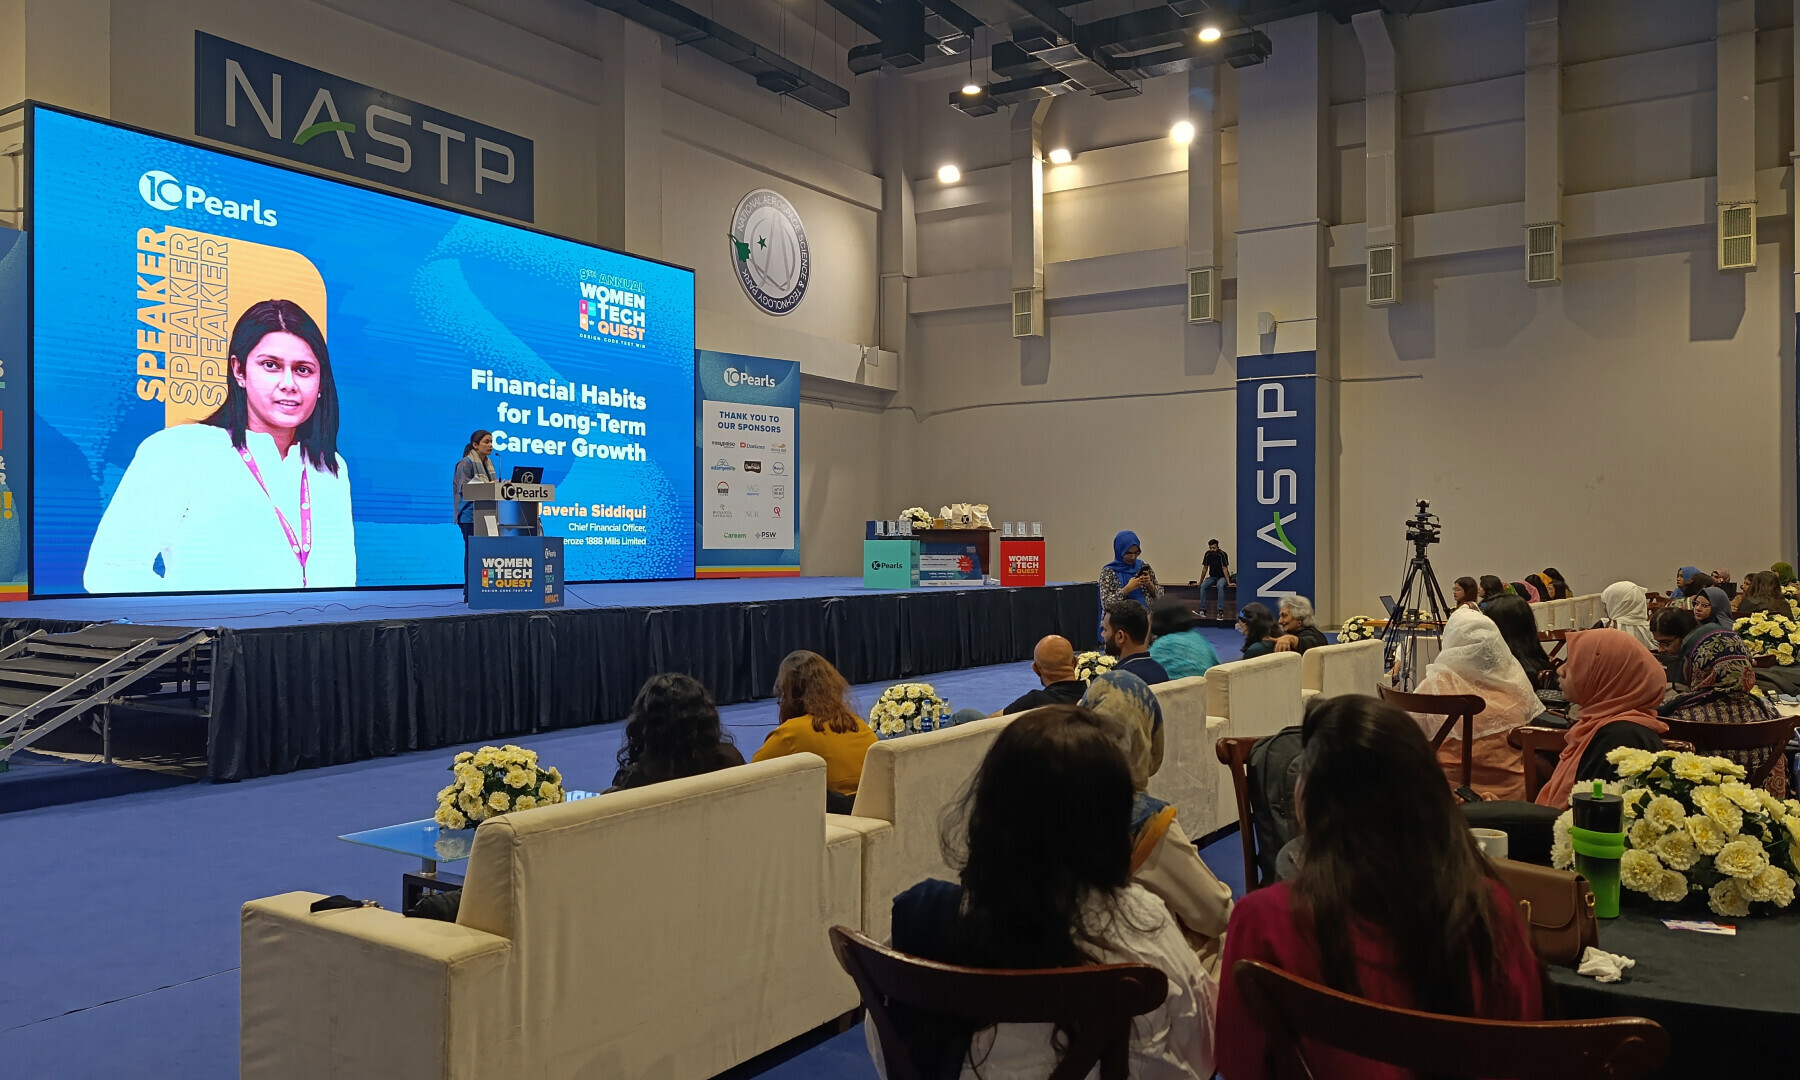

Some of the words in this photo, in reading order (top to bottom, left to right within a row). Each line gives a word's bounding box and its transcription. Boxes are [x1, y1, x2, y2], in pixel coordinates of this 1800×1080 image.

[225, 58, 515, 195] NASTP
[138, 170, 278, 227] 10Pearls
[737, 196, 763, 232] NATIONAL
[763, 195, 802, 232] AEROSPACE
[798, 235, 808, 280] SCIENCE
[599, 273, 645, 293] ANNUAL
[742, 268, 760, 296] PARK
[798, 280, 805, 288] &
[580, 282, 646, 310] WOMEN
[757, 289, 802, 310] TECHNOLOGY
[137, 227, 166, 402] SPEAKER
[169, 233, 198, 405] SPEAKER
[200, 239, 228, 406] SPEAKER
[597, 302, 646, 327] TECH
[598, 321, 646, 340] QUEST
[471, 368, 576, 402] Financial
[581, 383, 647, 410] Habits
[723, 367, 776, 388] 10Pearls
[497, 401, 531, 425] for
[537, 405, 647, 436] Long-Term
[717, 421, 736, 430] OUR
[738, 423, 781, 434] SPONSORS
[719, 411, 748, 421] THANK
[750, 413, 767, 422] YOU
[769, 415, 780, 423] TO
[491, 430, 567, 456] Career
[571, 437, 647, 462] Growth
[501, 483, 548, 500] 10Pearls
[1256, 382, 1298, 598] NASTP
[538, 502, 587, 517] Javeria
[591, 503, 647, 521] Siddiqui
[568, 522, 588, 532] Chief
[589, 523, 621, 532] Financial
[622, 523, 647, 533] Officer,
[563, 538, 584, 546] eroze
[585, 537, 603, 546] 1888
[604, 537, 620, 546] Mills
[621, 537, 647, 546] Limited
[482, 558, 533, 568] WOMEN
[495, 568, 533, 579] TECH
[1016, 561, 1039, 569] TECH
[495, 579, 533, 588] QUEST
